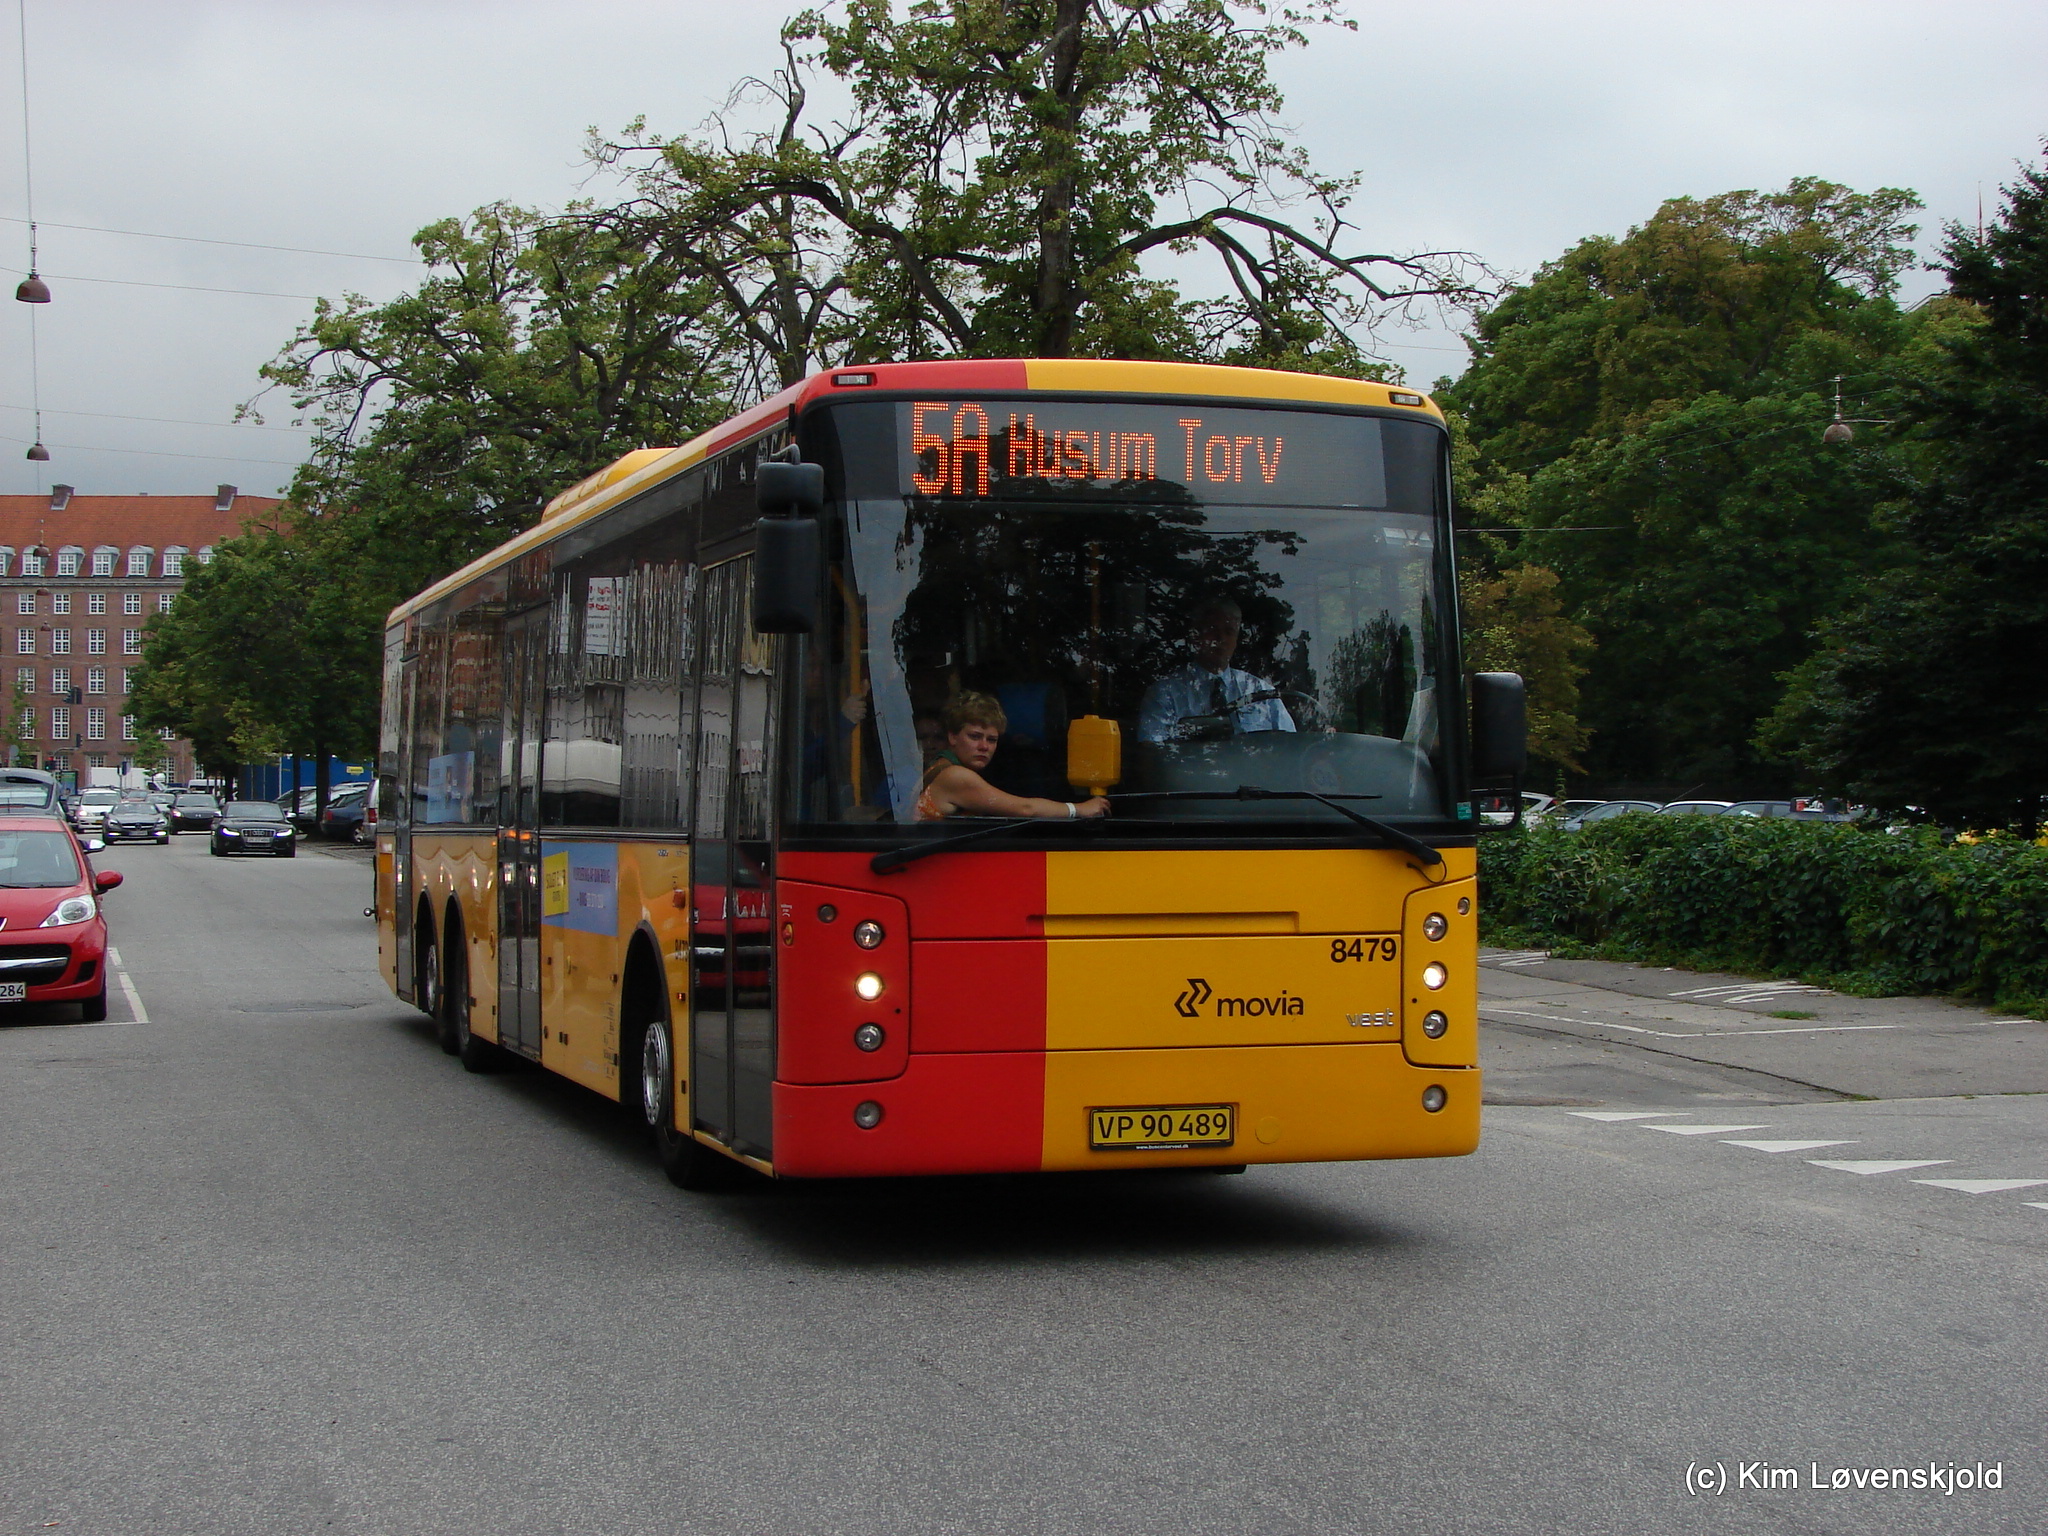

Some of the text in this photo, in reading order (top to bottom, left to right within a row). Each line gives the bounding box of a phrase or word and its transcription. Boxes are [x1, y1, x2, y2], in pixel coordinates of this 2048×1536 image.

[911, 401, 1284, 496] 5A Husum Torv
[1330, 937, 1397, 963] 8479
[0, 984, 24, 998] 284
[1216, 989, 1304, 1017] movia
[1345, 1007, 1394, 1027] vest
[1098, 1112, 1228, 1139] VP 90 489
